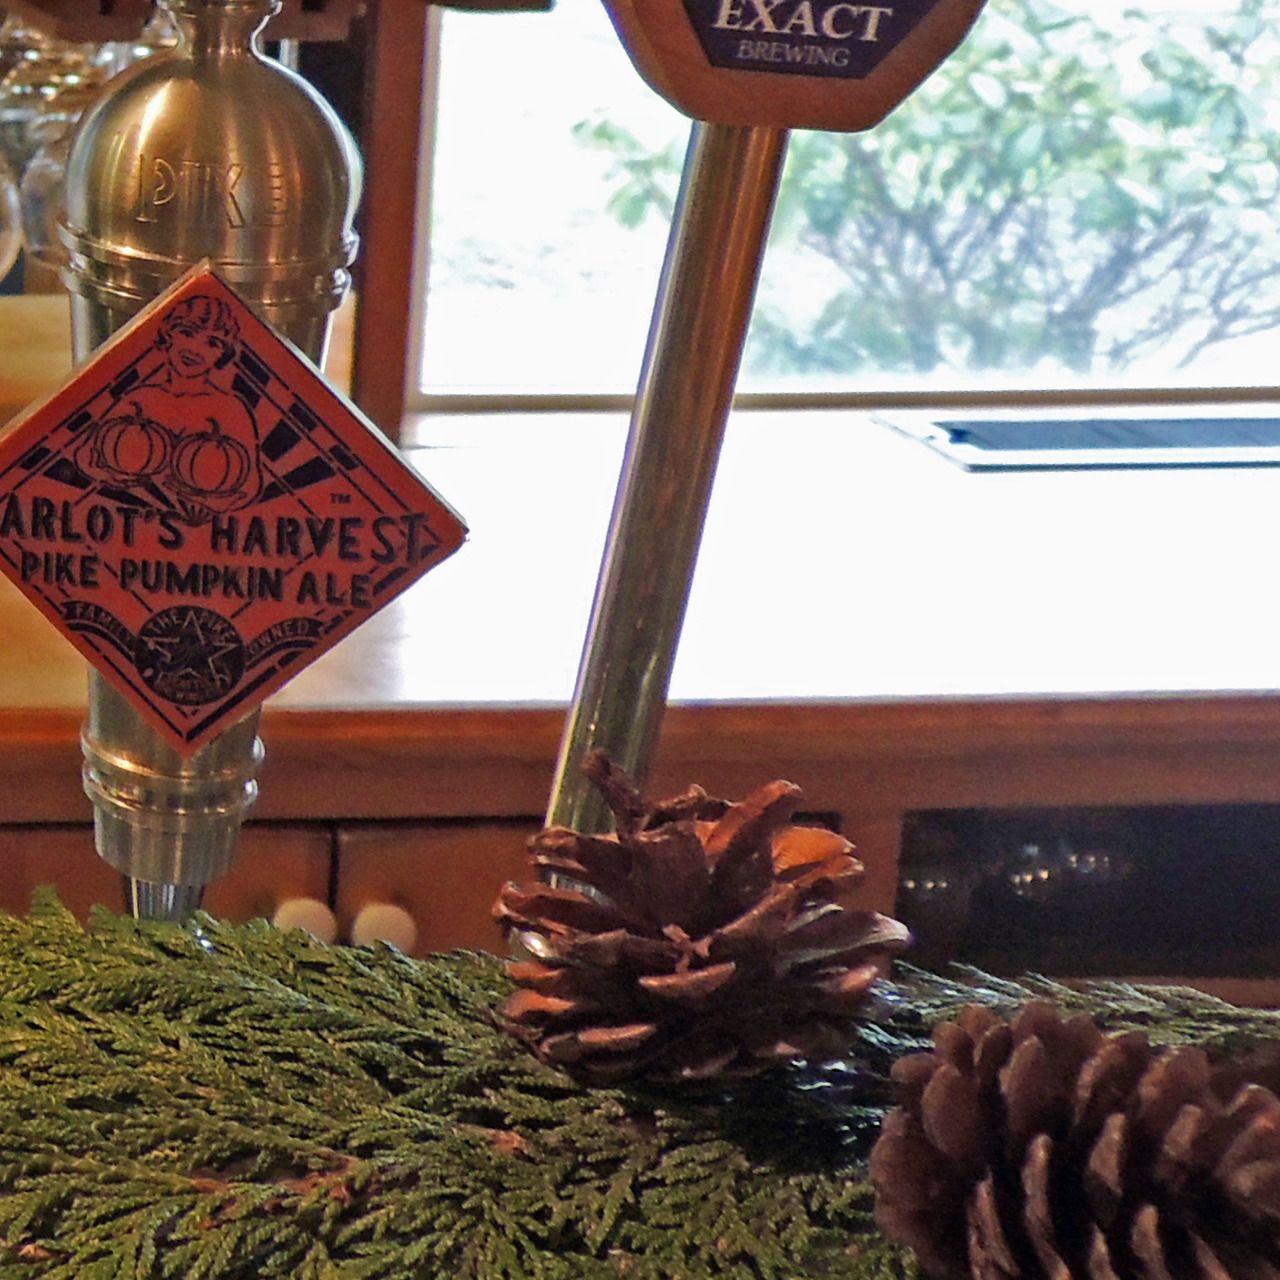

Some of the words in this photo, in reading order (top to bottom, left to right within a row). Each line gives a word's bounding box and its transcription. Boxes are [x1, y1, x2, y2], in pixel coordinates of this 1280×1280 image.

[736, 39, 851, 68] BREWING
[211, 511, 430, 566] HARVEST
[20, 550, 101, 589] PIKE
[120, 562, 284, 602] PUMPKIN
[296, 572, 373, 608] ALE
